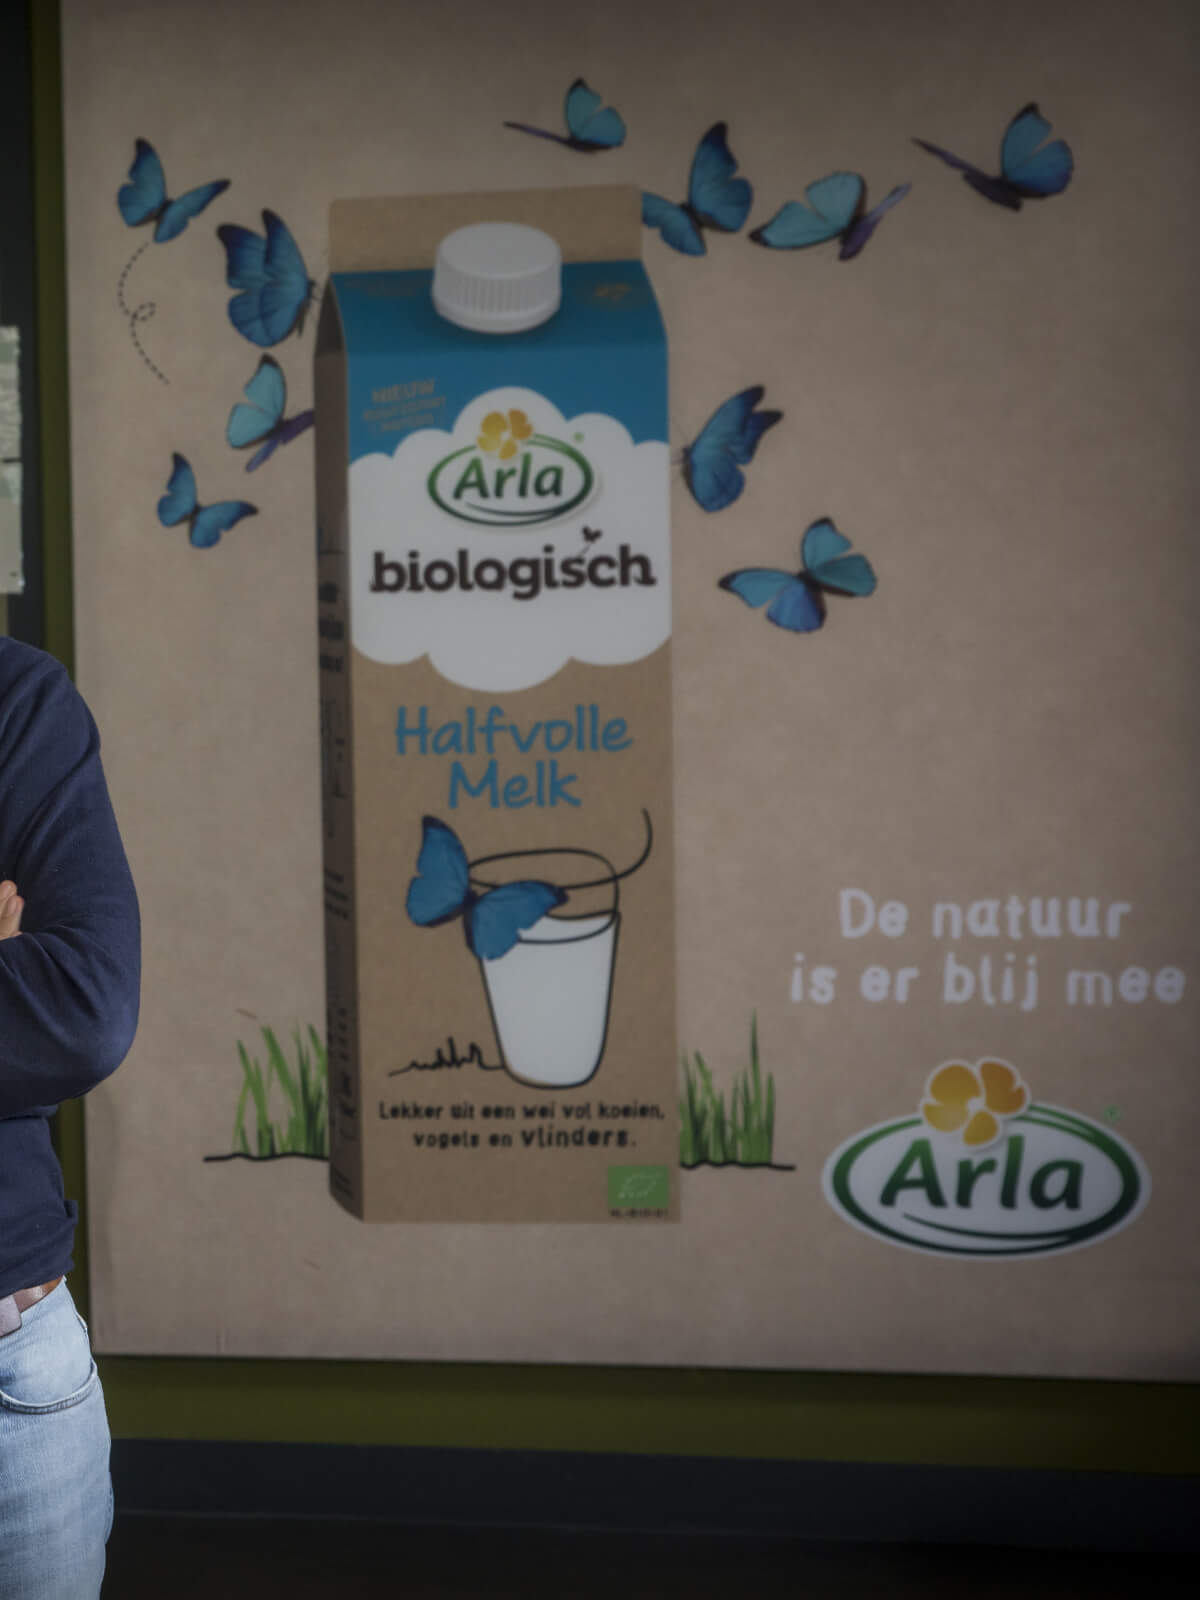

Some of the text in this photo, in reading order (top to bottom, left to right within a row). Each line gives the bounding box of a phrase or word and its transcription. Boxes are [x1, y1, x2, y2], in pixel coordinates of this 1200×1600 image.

[452, 453, 564, 500] Arla
[369, 543, 658, 601] biologisch
[393, 704, 634, 756] Halfvolle
[447, 759, 582, 809] Melk
[839, 888, 1131, 939] De natuur
[790, 951, 1186, 1011] is er blij mee
[379, 1101, 665, 1122] Lekker uit een wei vol koeien,
[414, 1126, 637, 1149] vogels en vlinders.
[878, 1133, 1085, 1211] Arla
